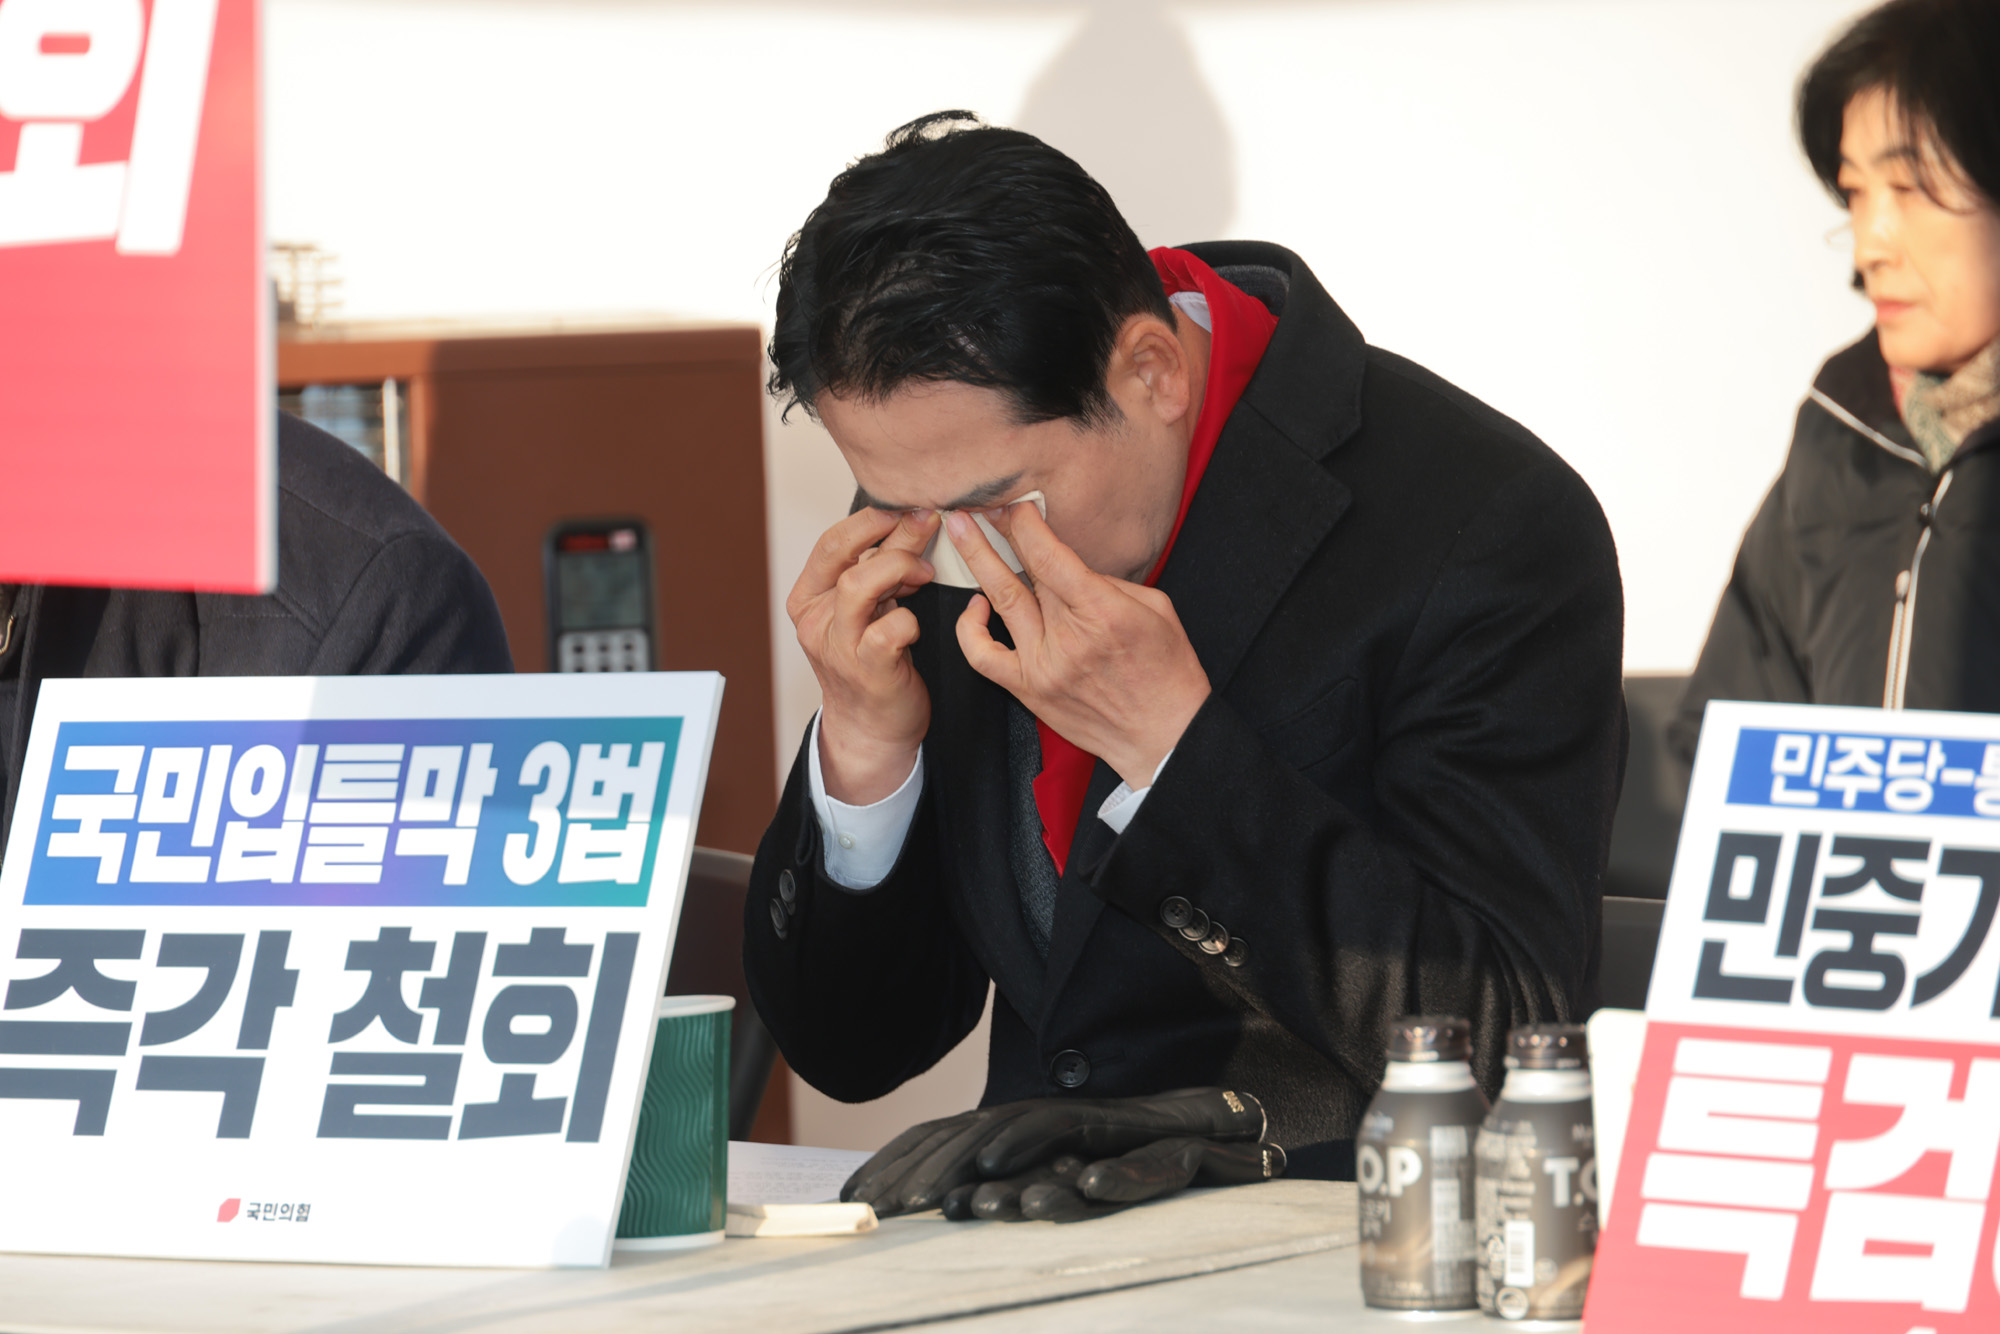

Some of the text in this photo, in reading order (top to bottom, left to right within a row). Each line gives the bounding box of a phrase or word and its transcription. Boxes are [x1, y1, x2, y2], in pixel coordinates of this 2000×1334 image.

[46, 740, 666, 886] 국민입틀막 3법
[0, 926, 642, 1144] 즉각 철회
[246, 1202, 311, 1222] 국민의힘
